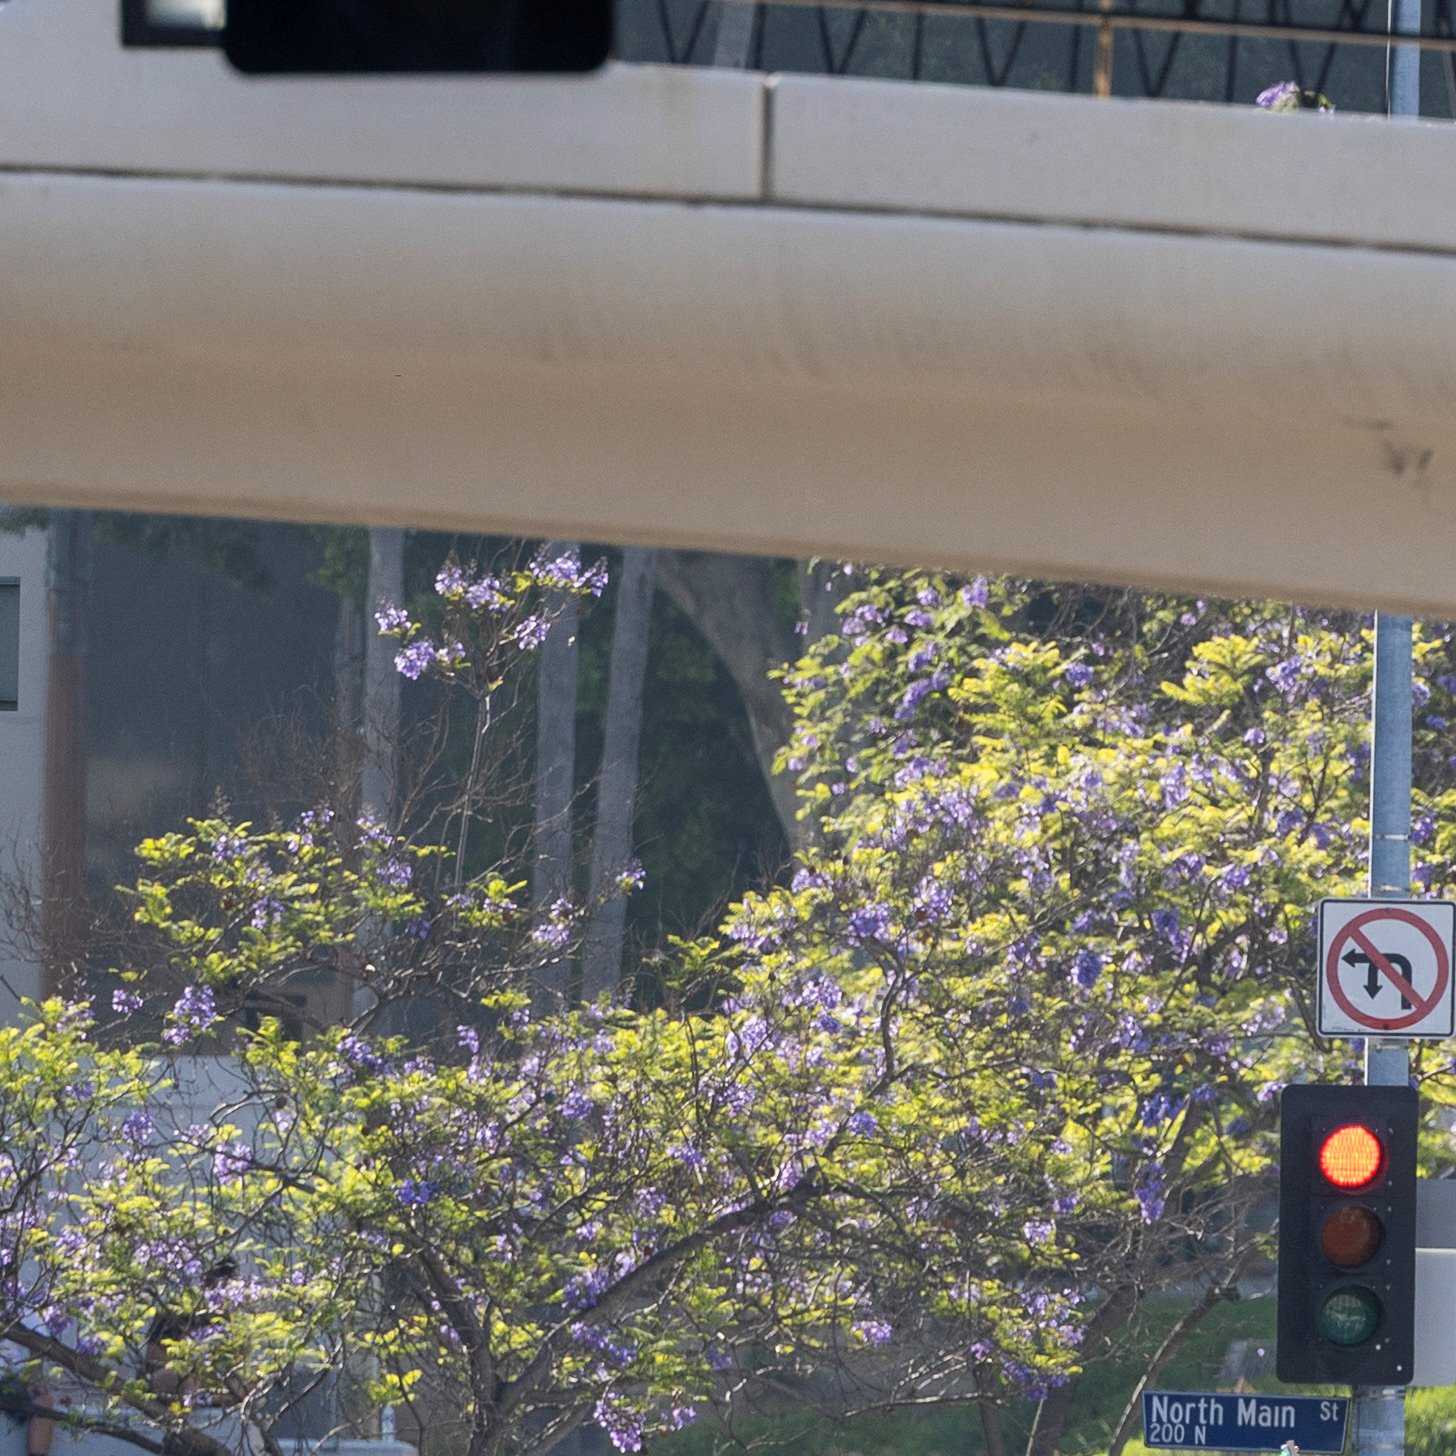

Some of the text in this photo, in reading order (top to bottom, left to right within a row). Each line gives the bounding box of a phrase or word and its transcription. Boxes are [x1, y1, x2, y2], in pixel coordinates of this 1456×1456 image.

[1151, 1396, 1339, 1428] North Main St
[1150, 1423, 1206, 1444] 200 N
